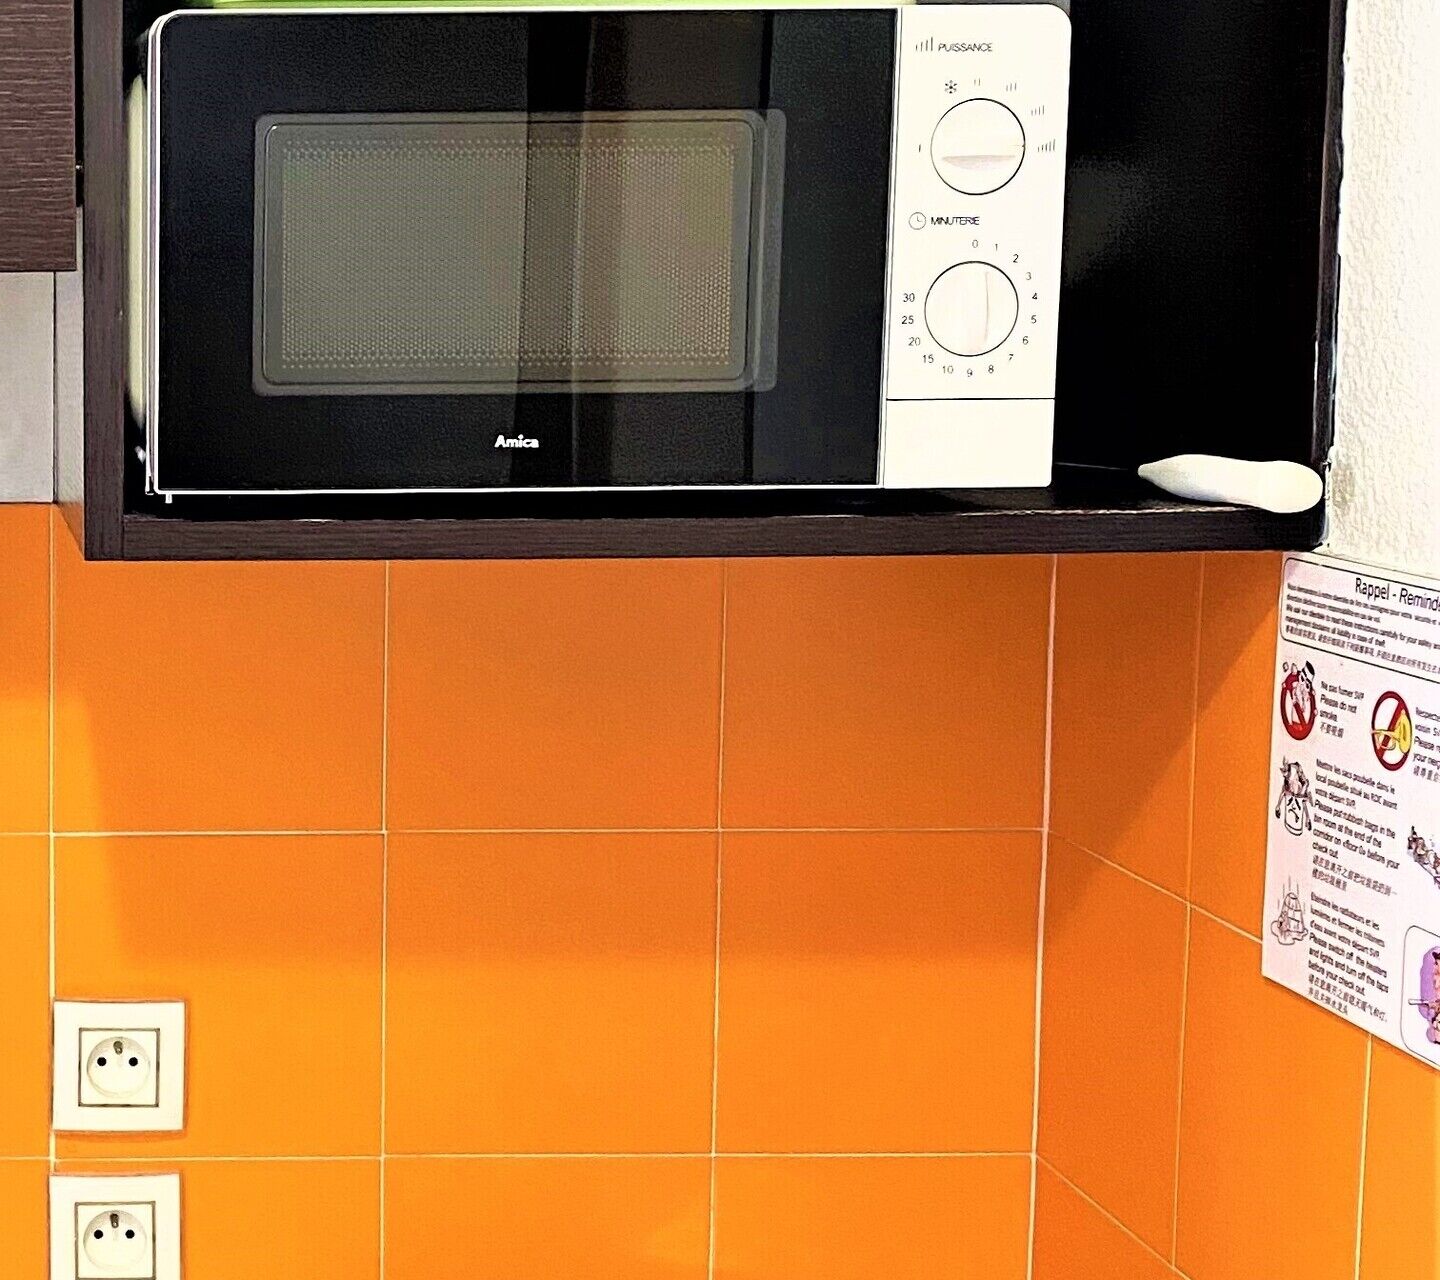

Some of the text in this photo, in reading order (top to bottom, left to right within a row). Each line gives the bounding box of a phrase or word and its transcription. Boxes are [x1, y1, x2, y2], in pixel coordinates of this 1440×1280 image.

[938, 41, 993, 52] PUISSANCE
[930, 216, 980, 226] MINUTERIE
[1013, 254, 1019, 263] 2
[1025, 272, 1032, 280] 3
[903, 293, 915, 302] 30
[901, 315, 914, 325] 25
[1031, 315, 1037, 323] 5
[908, 337, 920, 346] 20
[1023, 336, 1029, 345] 6
[923, 354, 934, 364] 15
[942, 365, 953, 374] 10
[967, 368, 973, 377] 9
[988, 365, 994, 373] 8
[494, 434, 539, 448] Amica
[1355, 577, 1390, 601] Rappel
[1399, 588, 1440, 612] Remind
